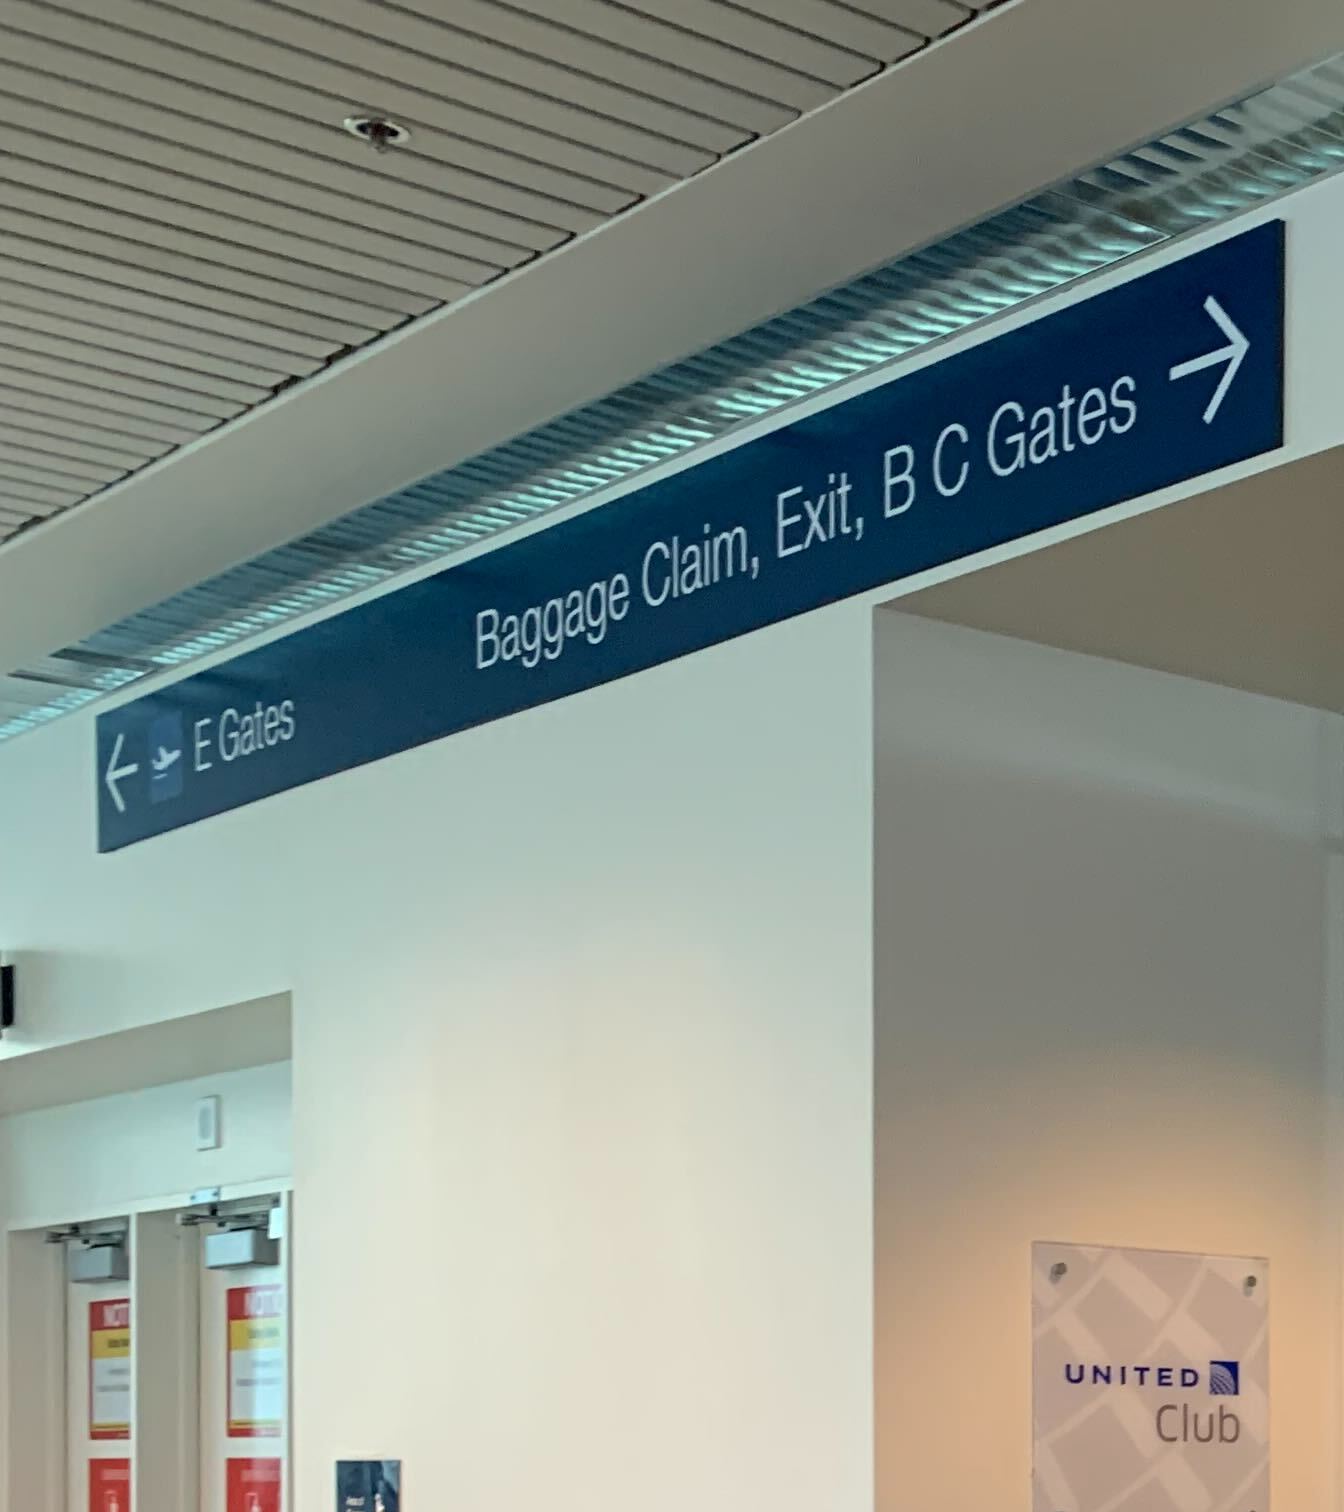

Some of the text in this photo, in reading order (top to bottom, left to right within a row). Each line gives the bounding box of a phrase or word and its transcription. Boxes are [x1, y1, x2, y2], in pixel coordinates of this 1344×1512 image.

[476, 376, 1136, 670] Baggage Claim, Exit, B C Gates
[194, 700, 296, 772] E Gates
[1065, 1364, 1199, 1388] UNITED
[1156, 1403, 1241, 1444] Club
